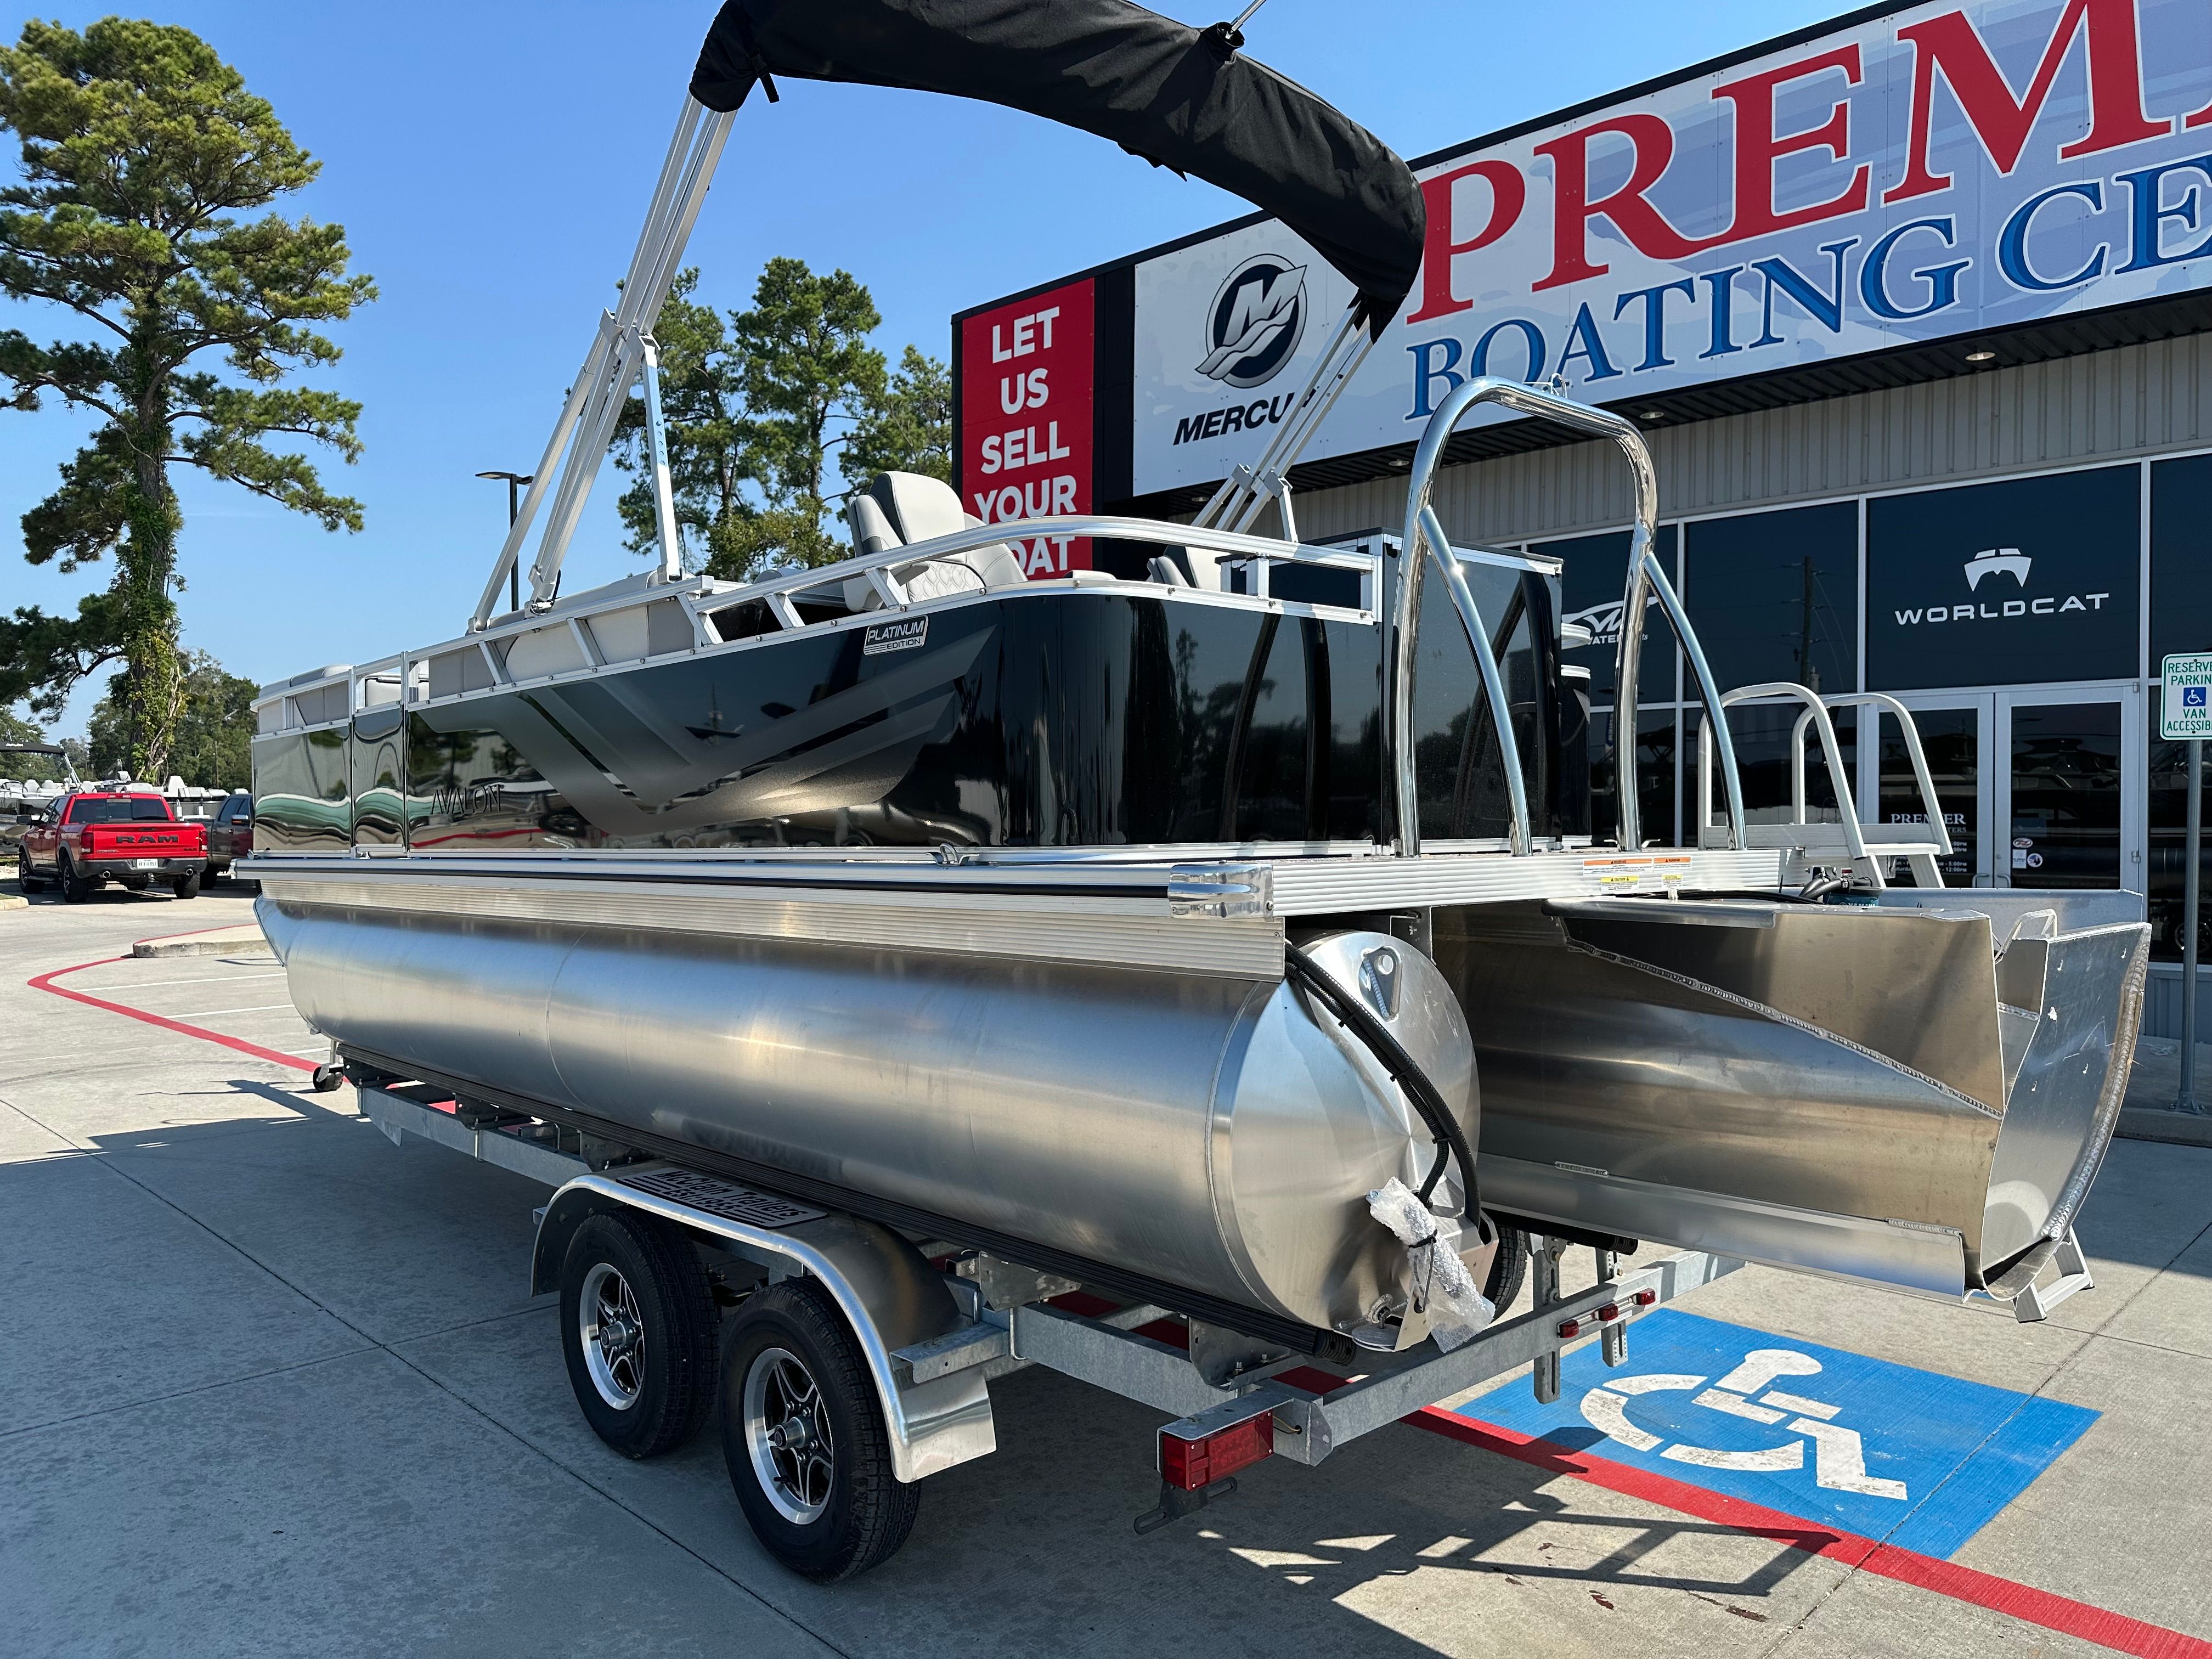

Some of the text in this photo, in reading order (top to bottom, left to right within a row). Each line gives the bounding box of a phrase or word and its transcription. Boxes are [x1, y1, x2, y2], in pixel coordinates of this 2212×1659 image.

[1407, 0, 2212, 325] PREM
[992, 306, 1060, 364] LET
[1405, 219, 1970, 420] BOATING
[1000, 369, 1049, 415] US
[981, 421, 1070, 475] SELL
[974, 475, 1077, 526] YOUR
[867, 620, 925, 642] PLATINUM
[1895, 592, 2109, 625] WORLDCAT
[887, 637, 921, 650] EDITION
[2183, 708, 2206, 719] VAN
[431, 784, 503, 815] AVALON
[116, 836, 178, 844] RAM
[652, 1170, 808, 1217] McClain Trailers
